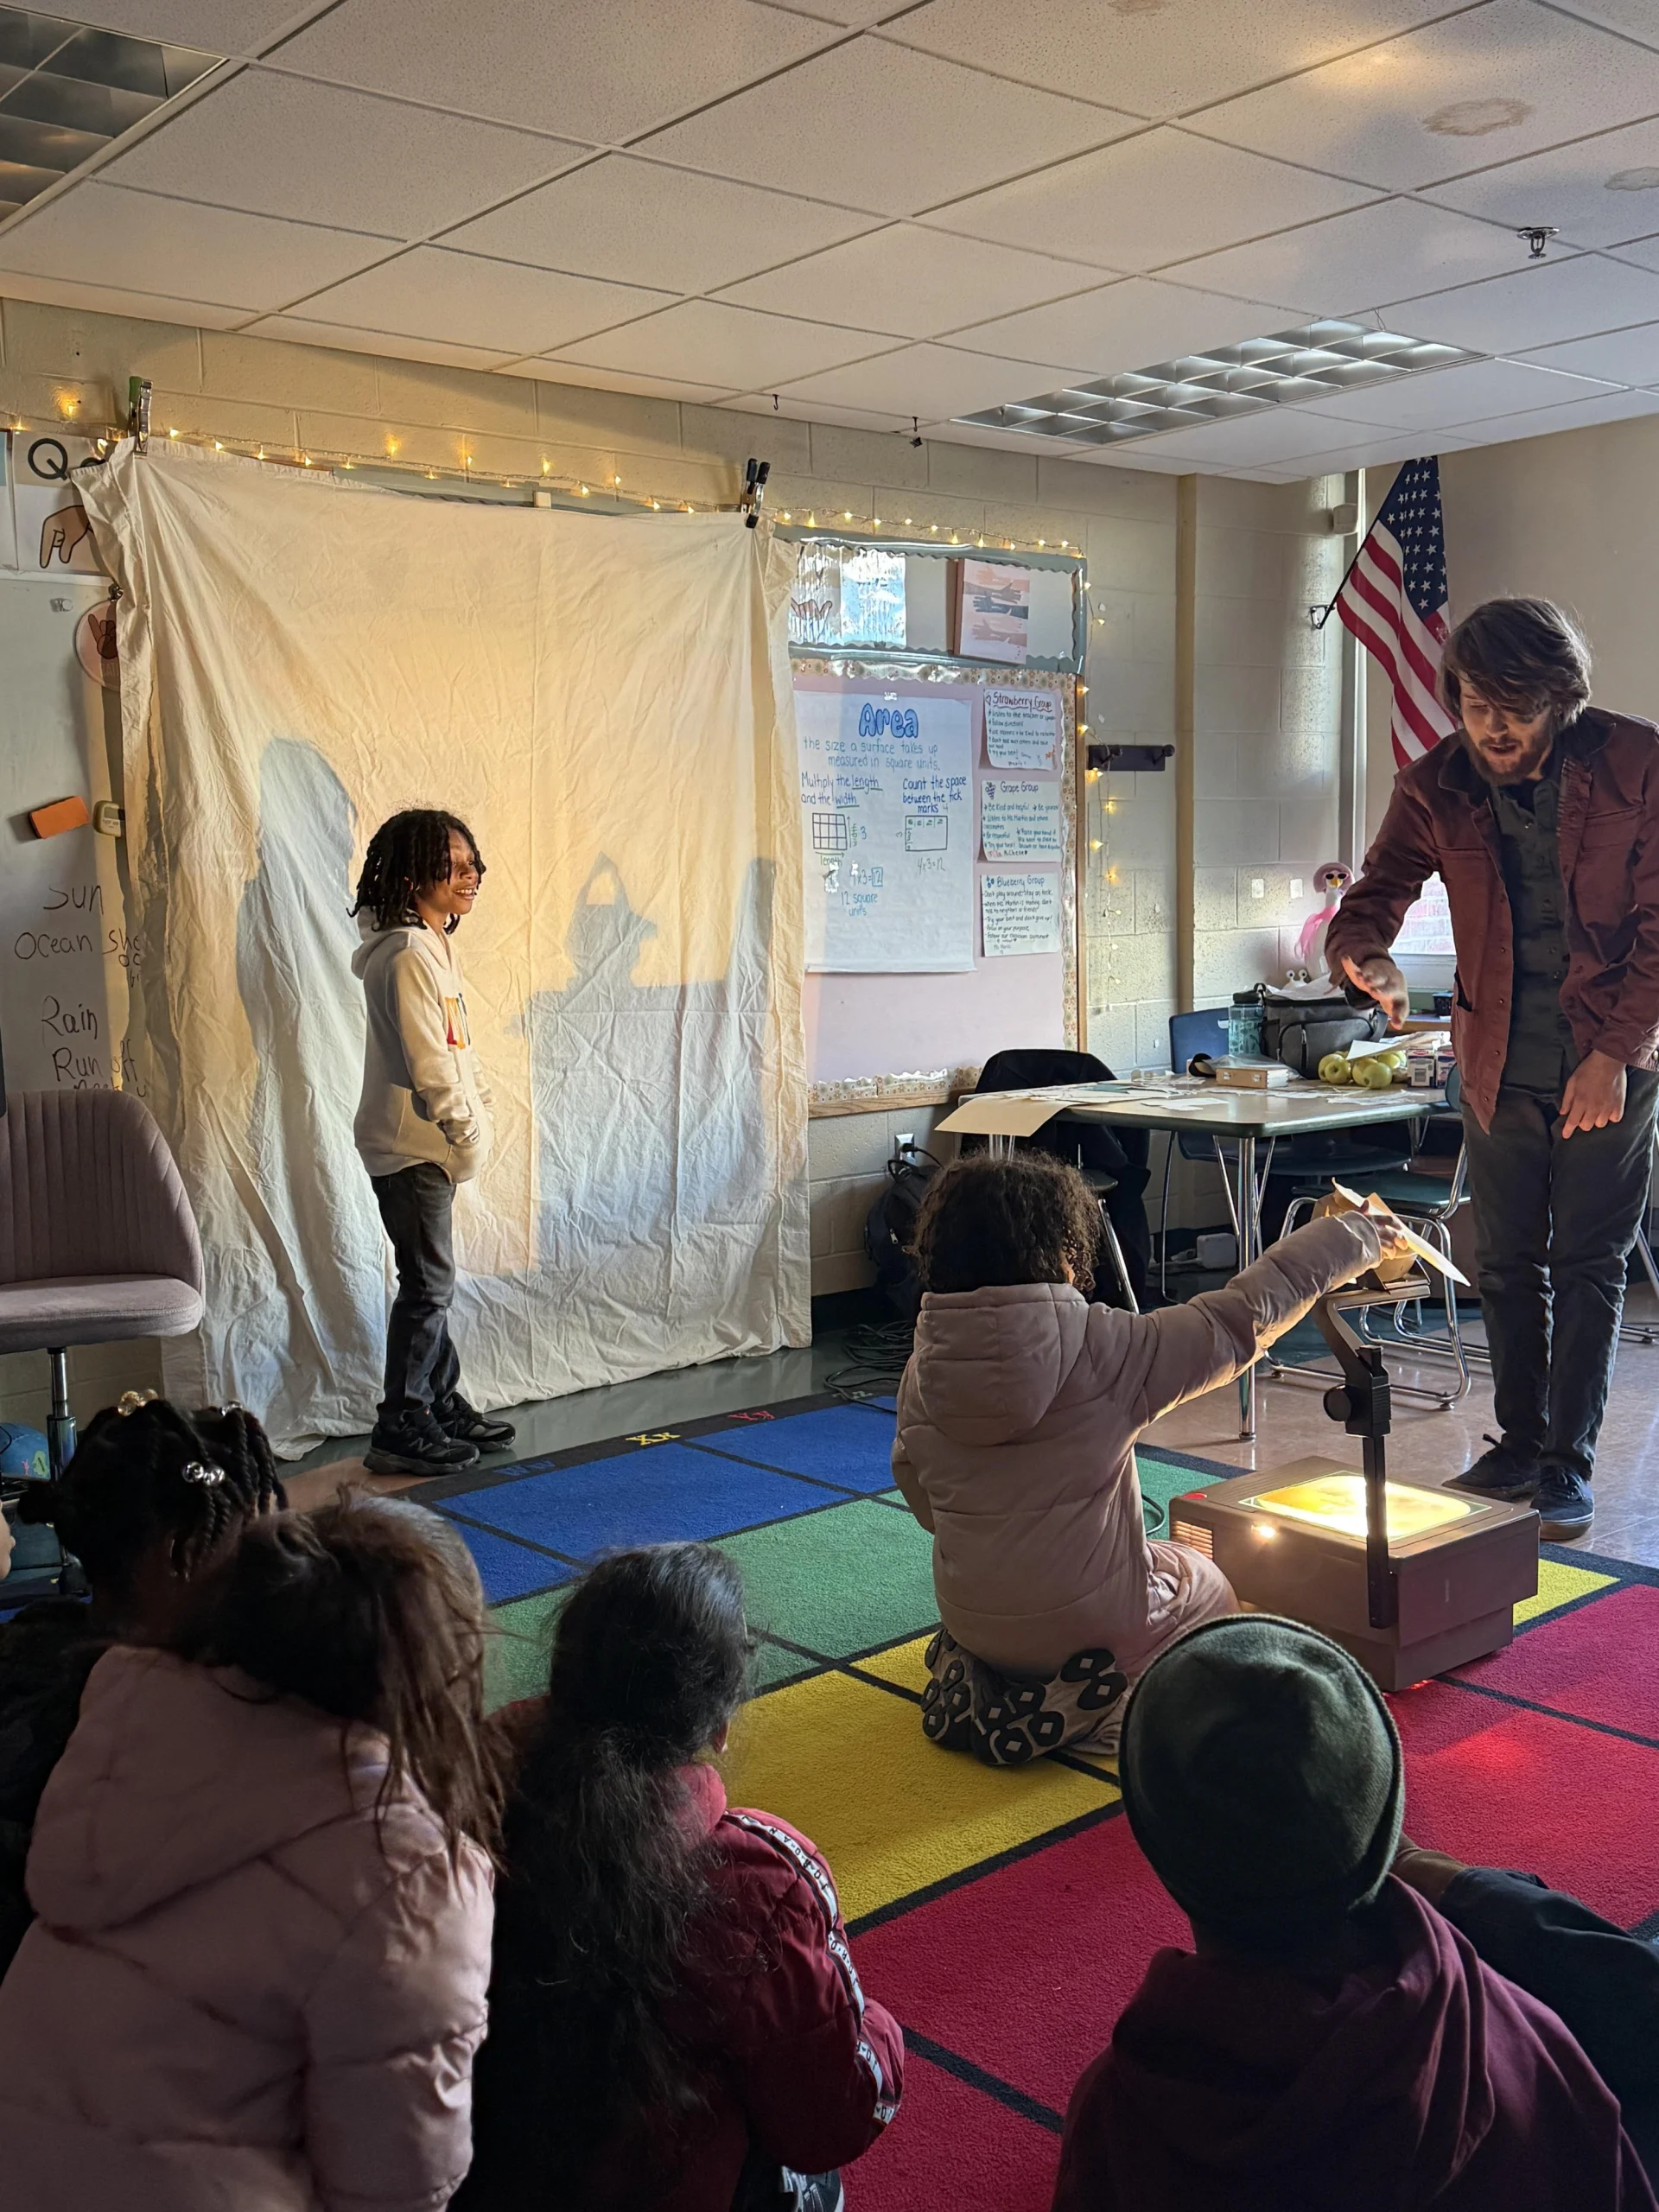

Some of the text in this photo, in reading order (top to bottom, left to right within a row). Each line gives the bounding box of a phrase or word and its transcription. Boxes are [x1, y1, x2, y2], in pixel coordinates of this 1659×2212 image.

[28, 437, 68, 481] Q
[993, 691, 1052, 712] Strawberry Group
[858, 702, 918, 739] Area
[803, 736, 939, 757] the size a surface takes up
[828, 754, 868, 767] measured
[870, 757, 880, 767] in
[886, 757, 912, 772] square
[801, 771, 880, 799] Multiply the length
[903, 775, 967, 792] Count the space
[1001, 781, 1039, 794] Grape Group
[801, 792, 857, 805] and the width
[903, 788, 963, 804] between the tick
[918, 803, 938, 813] marks
[860, 826, 867, 840] 3
[997, 874, 1045, 890] Blueberry Group
[43, 884, 104, 915] Sun
[841, 891, 878, 906] 12 square
[849, 905, 867, 916] units
[14, 931, 93, 960] Ocean
[41, 995, 98, 1040] Rain
[52, 1047, 104, 1082] Run
